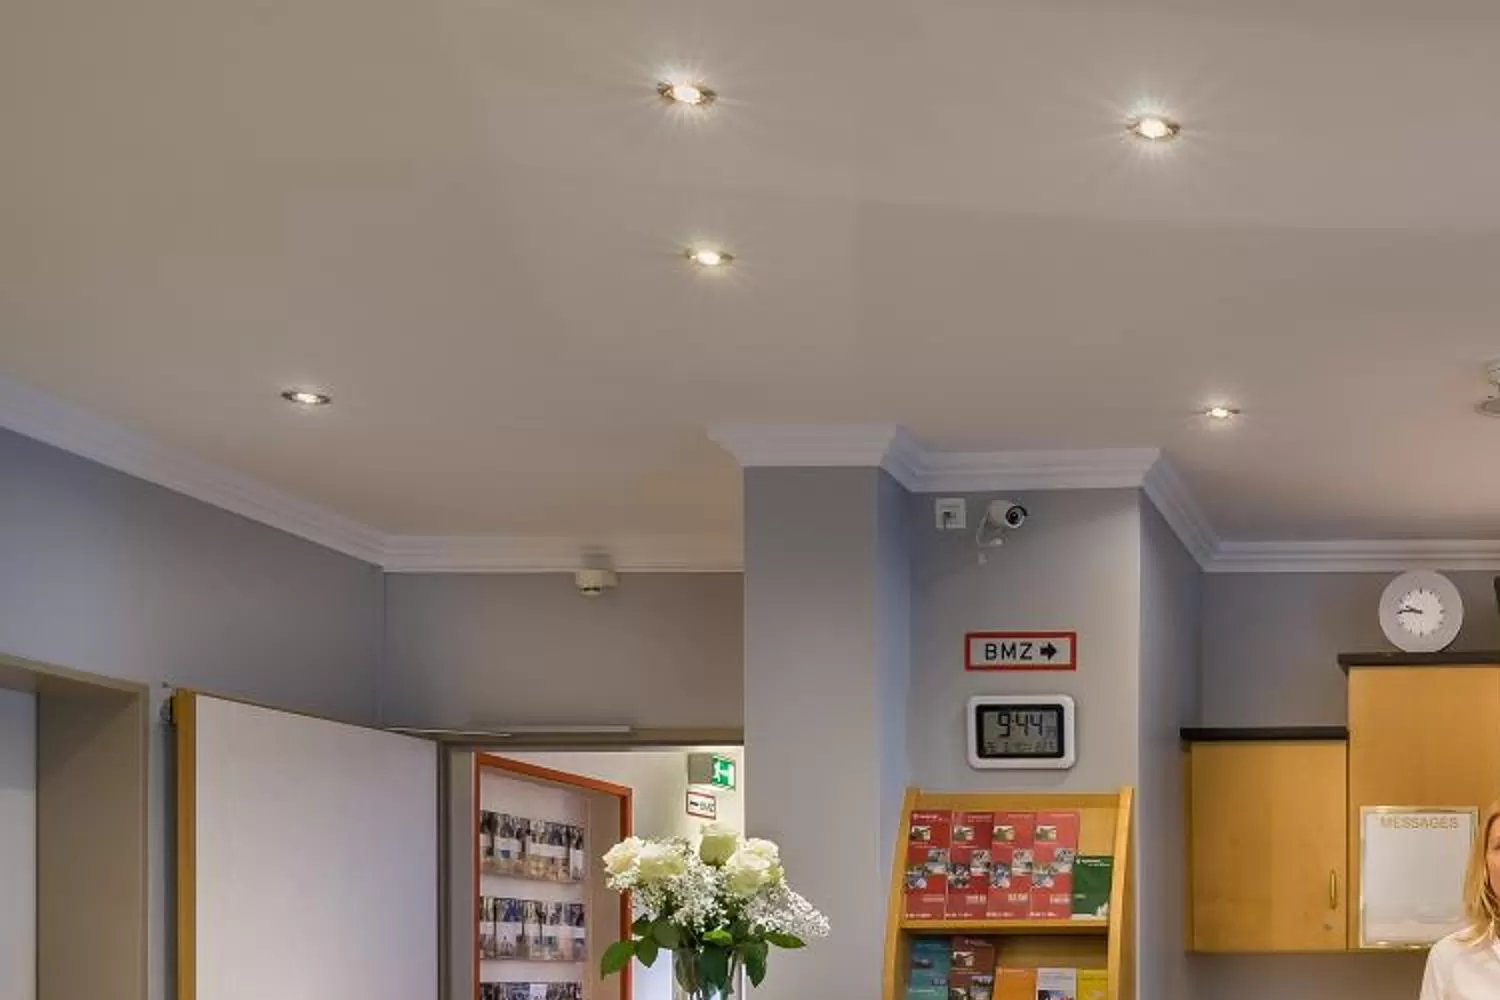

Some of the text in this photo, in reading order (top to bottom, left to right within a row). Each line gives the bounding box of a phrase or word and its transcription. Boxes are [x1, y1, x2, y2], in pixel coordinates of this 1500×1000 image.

[985, 643, 1033, 660] BMZ
[997, 712, 1043, 737] 9:44
[1380, 815, 1457, 829] MESSAGES
